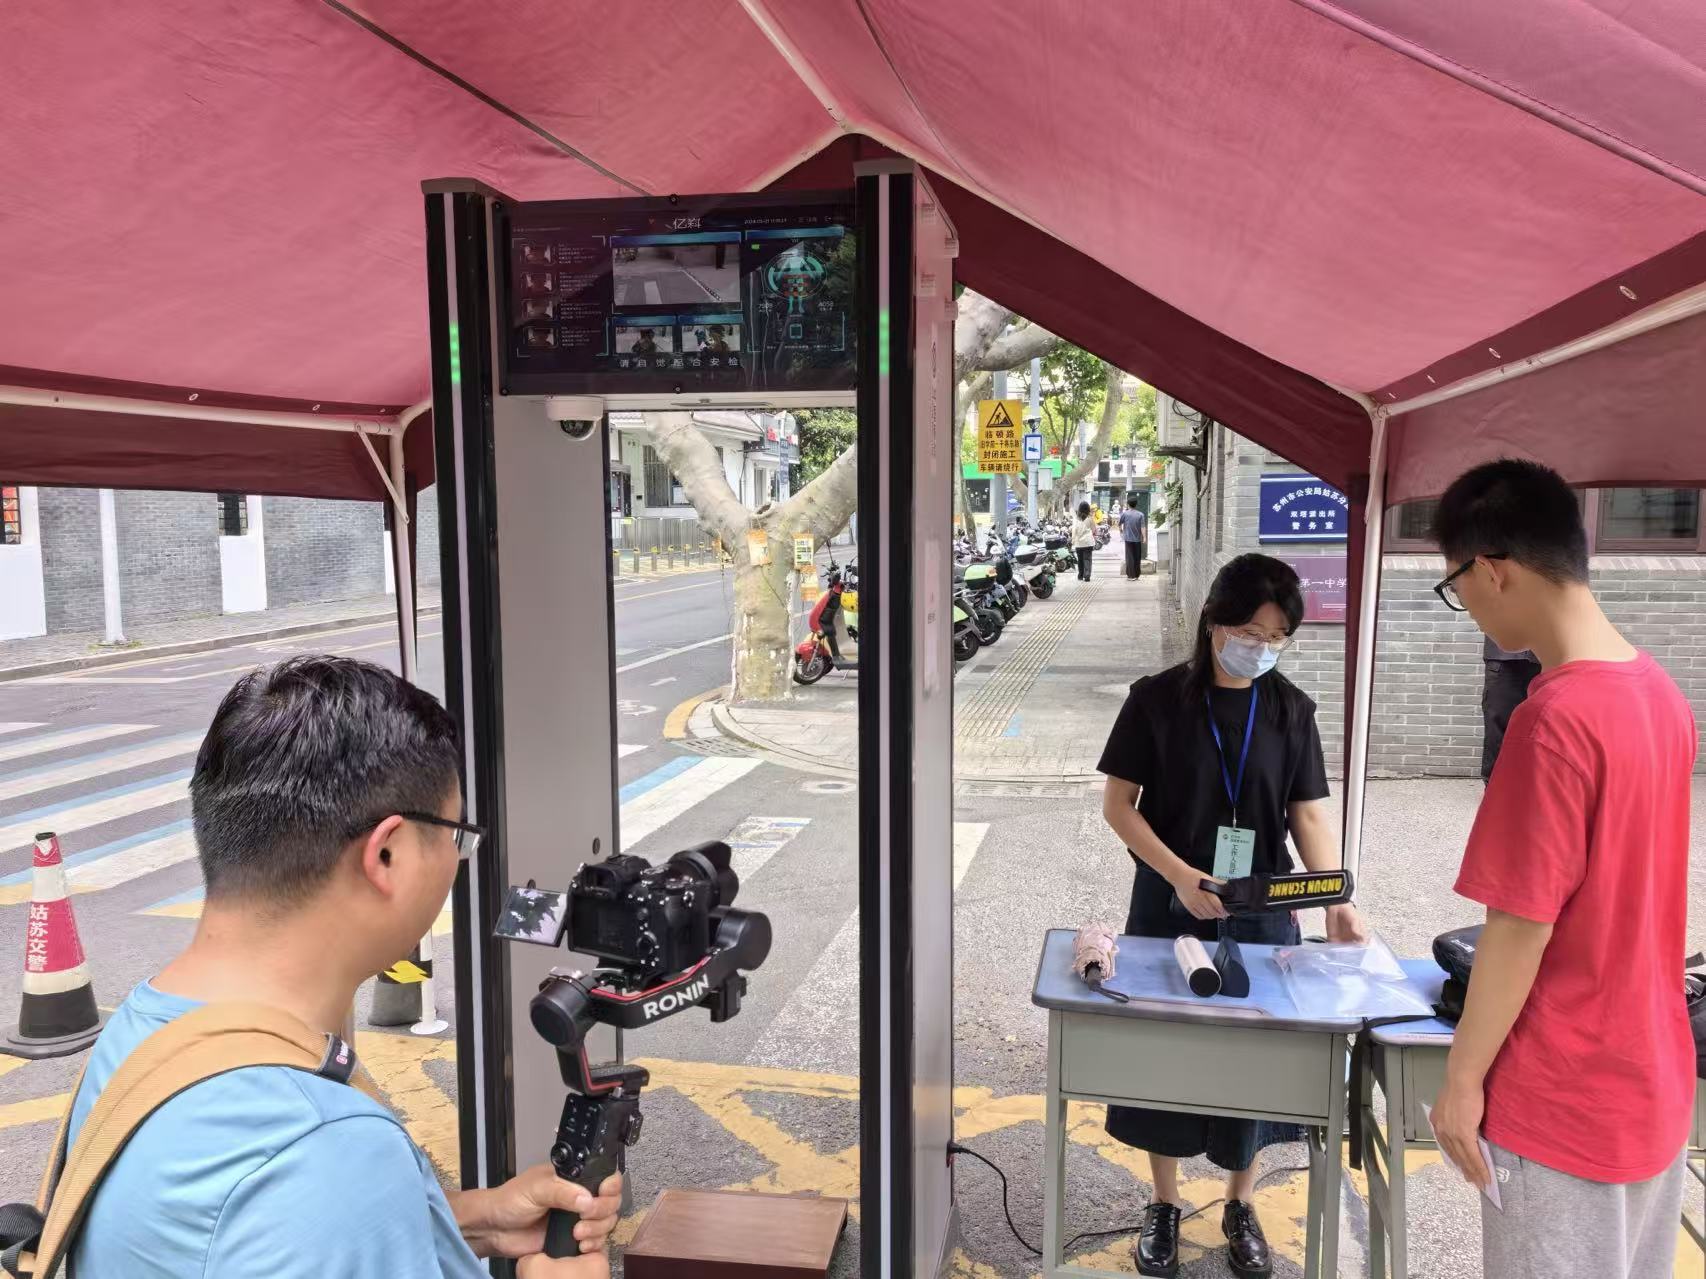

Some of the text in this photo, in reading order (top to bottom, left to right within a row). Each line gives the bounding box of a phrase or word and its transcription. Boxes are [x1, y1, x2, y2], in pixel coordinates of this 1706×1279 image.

[619, 357, 739, 368] 请自觉配合安检
[984, 450, 1016, 459] 封闭施工
[980, 463, 1019, 472] 车辆请绕行
[1272, 487, 1349, 512] 苏州市公安局姑苏分
[1290, 509, 1336, 518] 双塔派出所
[1292, 521, 1334, 530] 警务室
[1307, 878, 1342, 893] ANDUN
[28, 904, 49, 972] 姑苏交警
[642, 974, 709, 1019] RONIN
